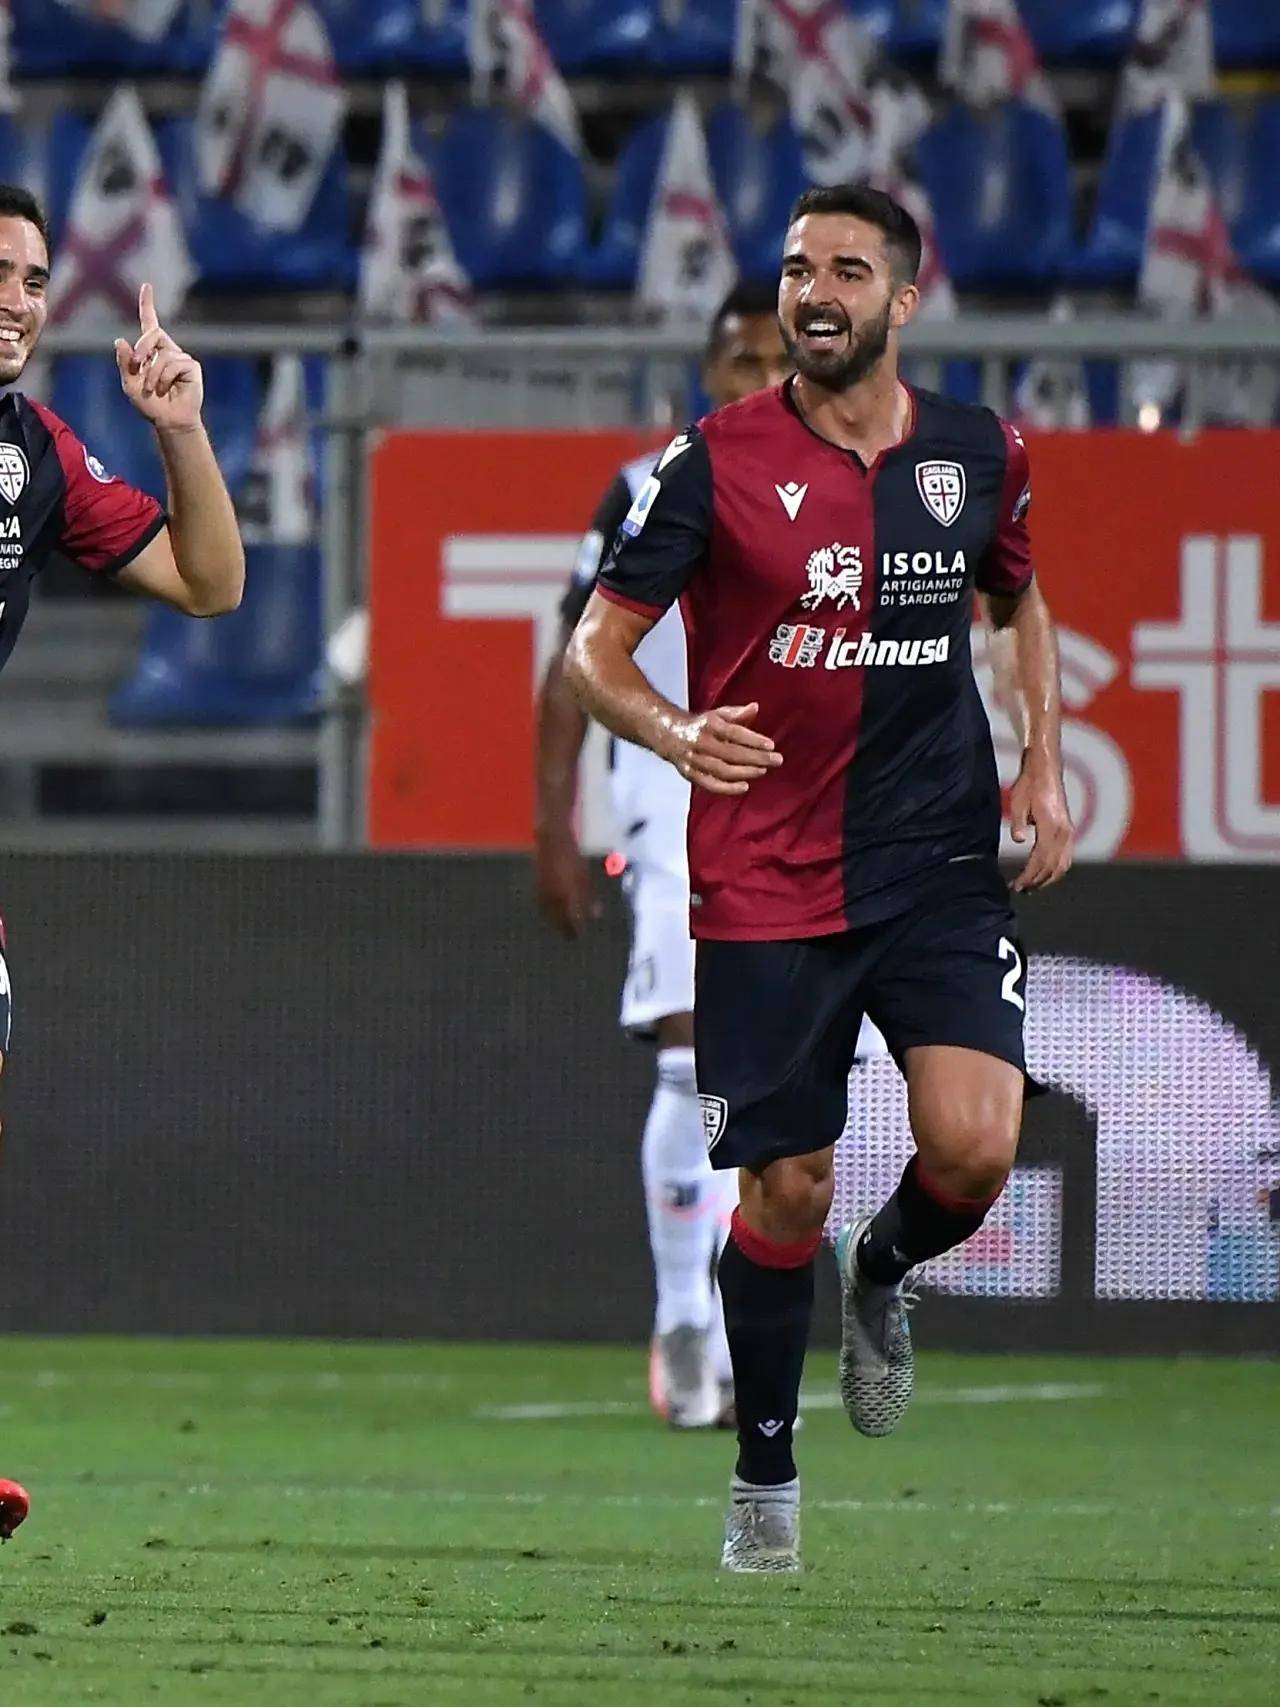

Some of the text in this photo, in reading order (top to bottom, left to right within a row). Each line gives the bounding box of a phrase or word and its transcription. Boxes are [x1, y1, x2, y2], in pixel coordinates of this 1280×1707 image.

[882, 550, 967, 576] ISOLA
[880, 577, 963, 593] ARTIGIANATO
[880, 592, 959, 607] DI SARDEGNA
